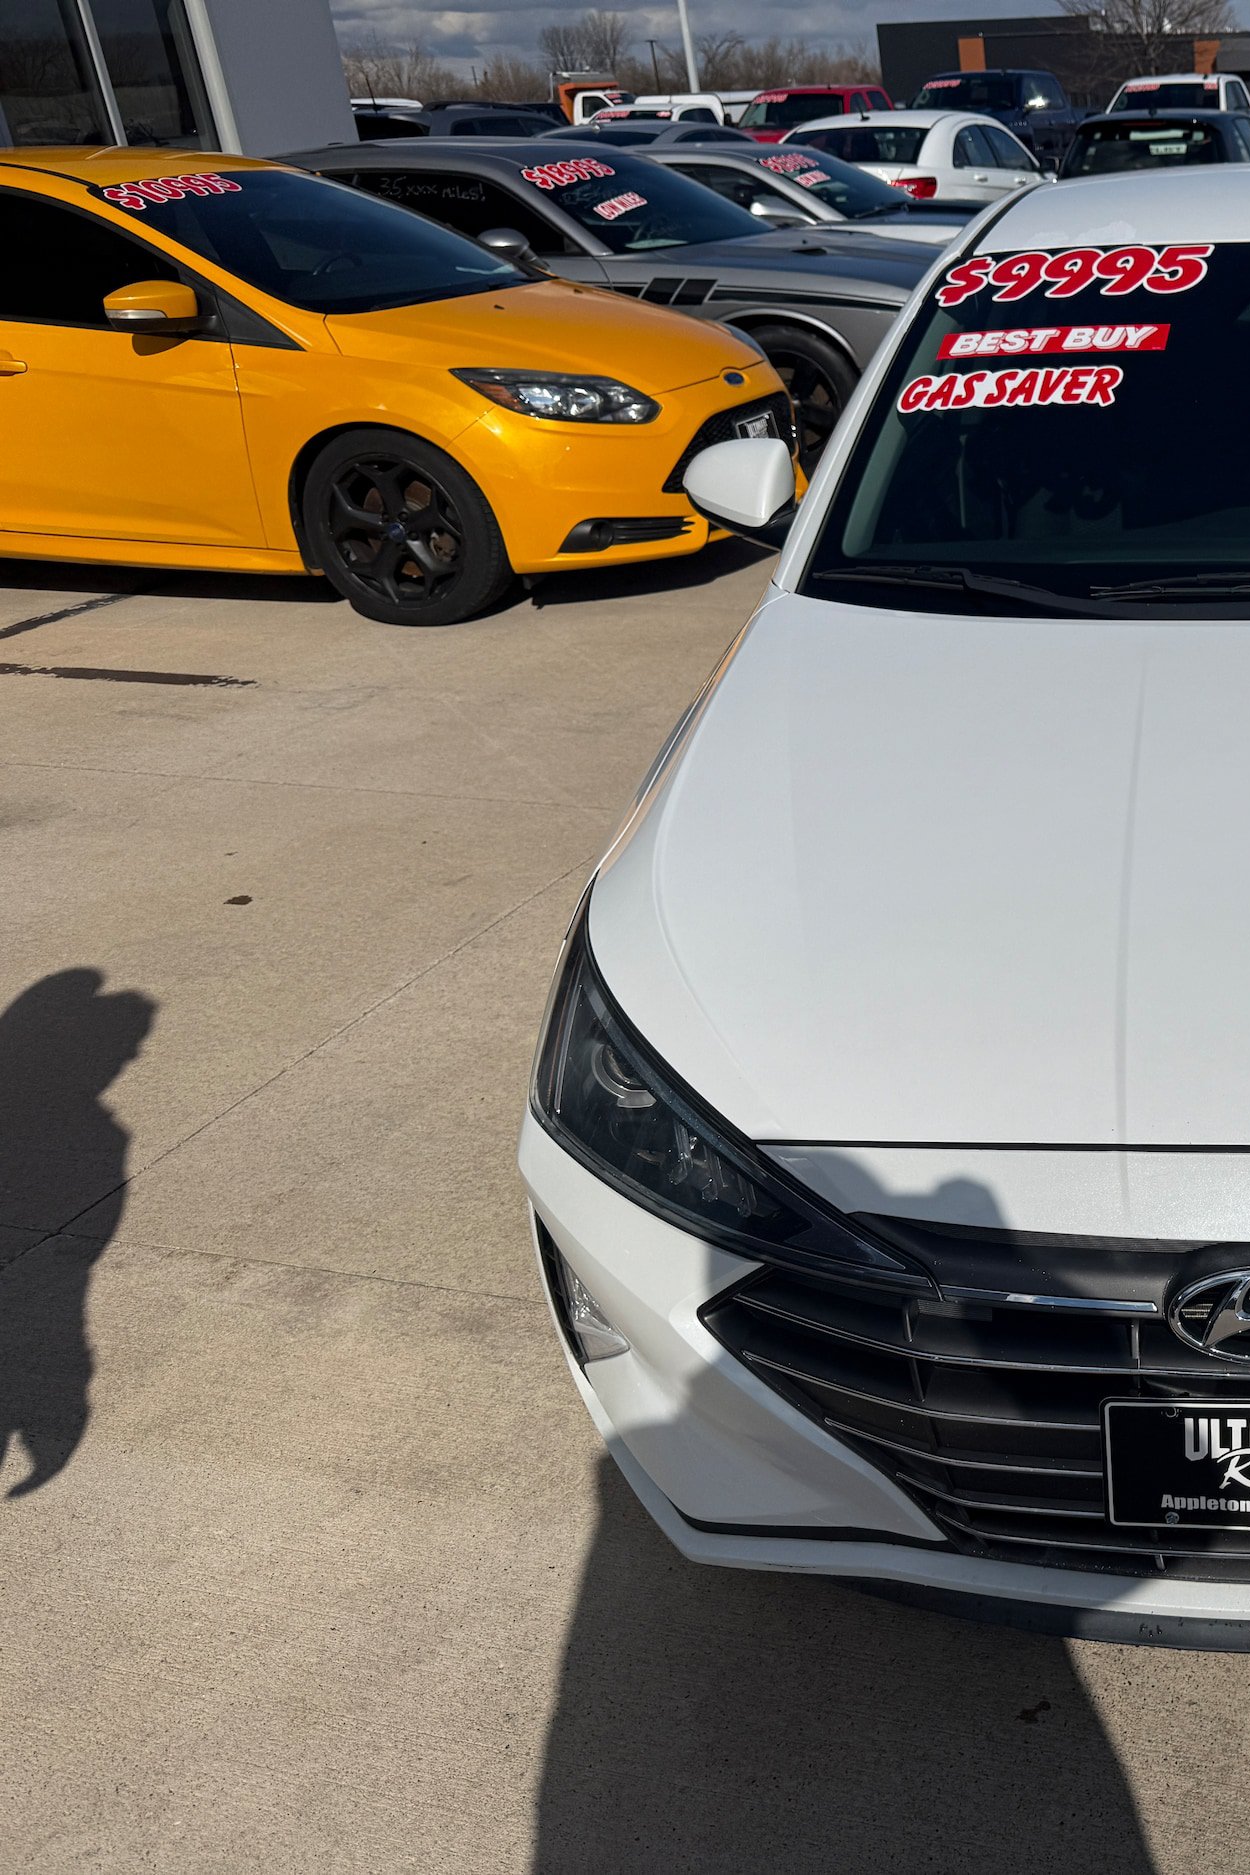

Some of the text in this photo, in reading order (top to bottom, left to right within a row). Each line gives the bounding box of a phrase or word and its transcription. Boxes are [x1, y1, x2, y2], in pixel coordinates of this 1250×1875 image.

[102, 172, 243, 210] $10995
[935, 245, 1215, 307] $9995
[948, 325, 1159, 356] BEST BUY
[897, 366, 1123, 413] GAS SAVER
